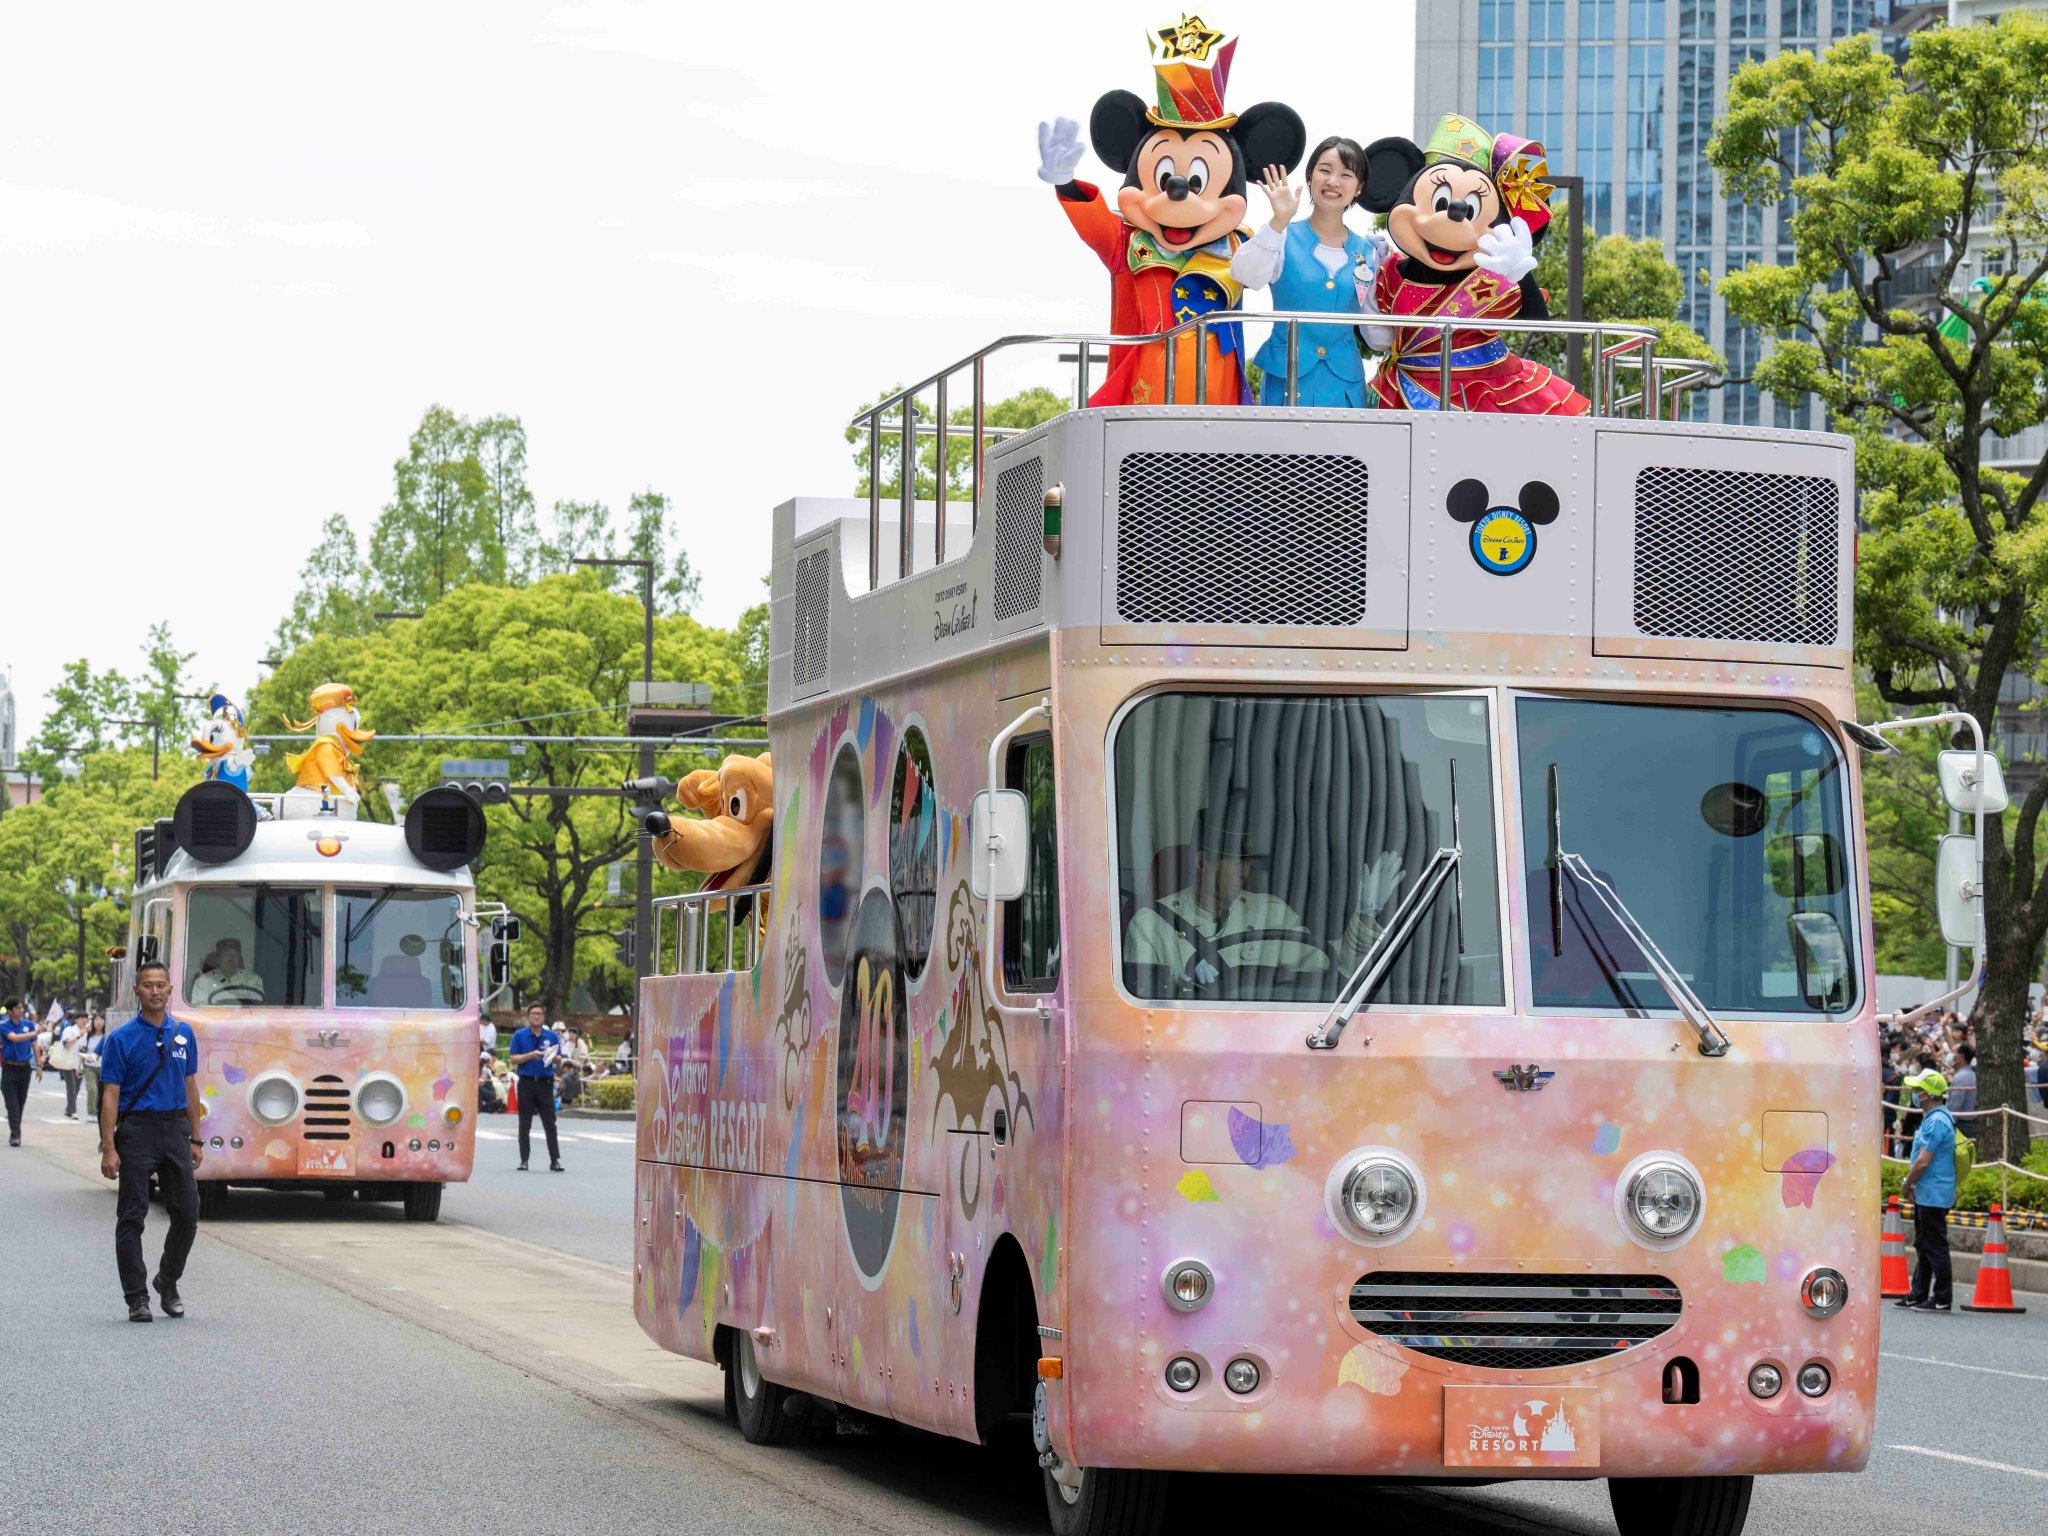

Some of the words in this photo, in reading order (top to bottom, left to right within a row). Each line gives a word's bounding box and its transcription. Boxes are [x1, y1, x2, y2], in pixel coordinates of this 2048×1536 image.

[1475, 516, 1490, 534] TOKYO
[1491, 510, 1513, 519] DISNEY
[1514, 515, 1531, 535] RESORT
[682, 1062, 707, 1095] TOKYO
[710, 1100, 767, 1172] RESORT
[1470, 1439, 1539, 1451] RESORT
